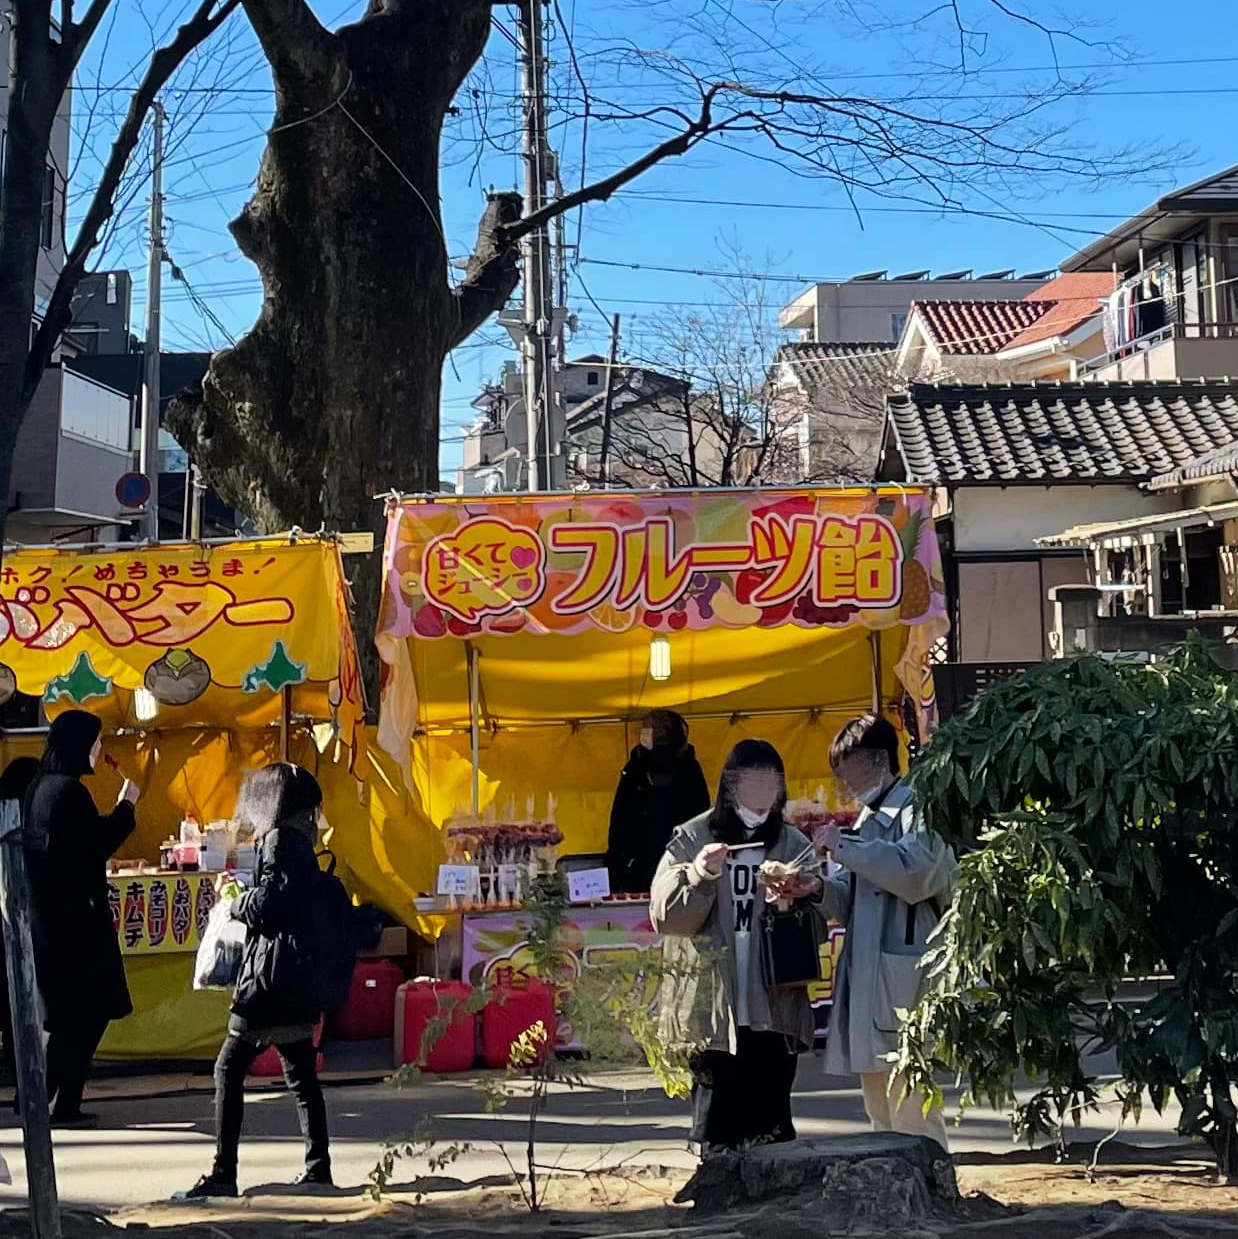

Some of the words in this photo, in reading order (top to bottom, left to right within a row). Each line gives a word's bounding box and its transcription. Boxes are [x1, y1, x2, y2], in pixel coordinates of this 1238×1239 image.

[436, 542, 508, 570] 甘くて
[551, 517, 898, 611] フルーツ飴
[437, 566, 530, 596] ジューシー
[124, 881, 145, 948] キムチ
